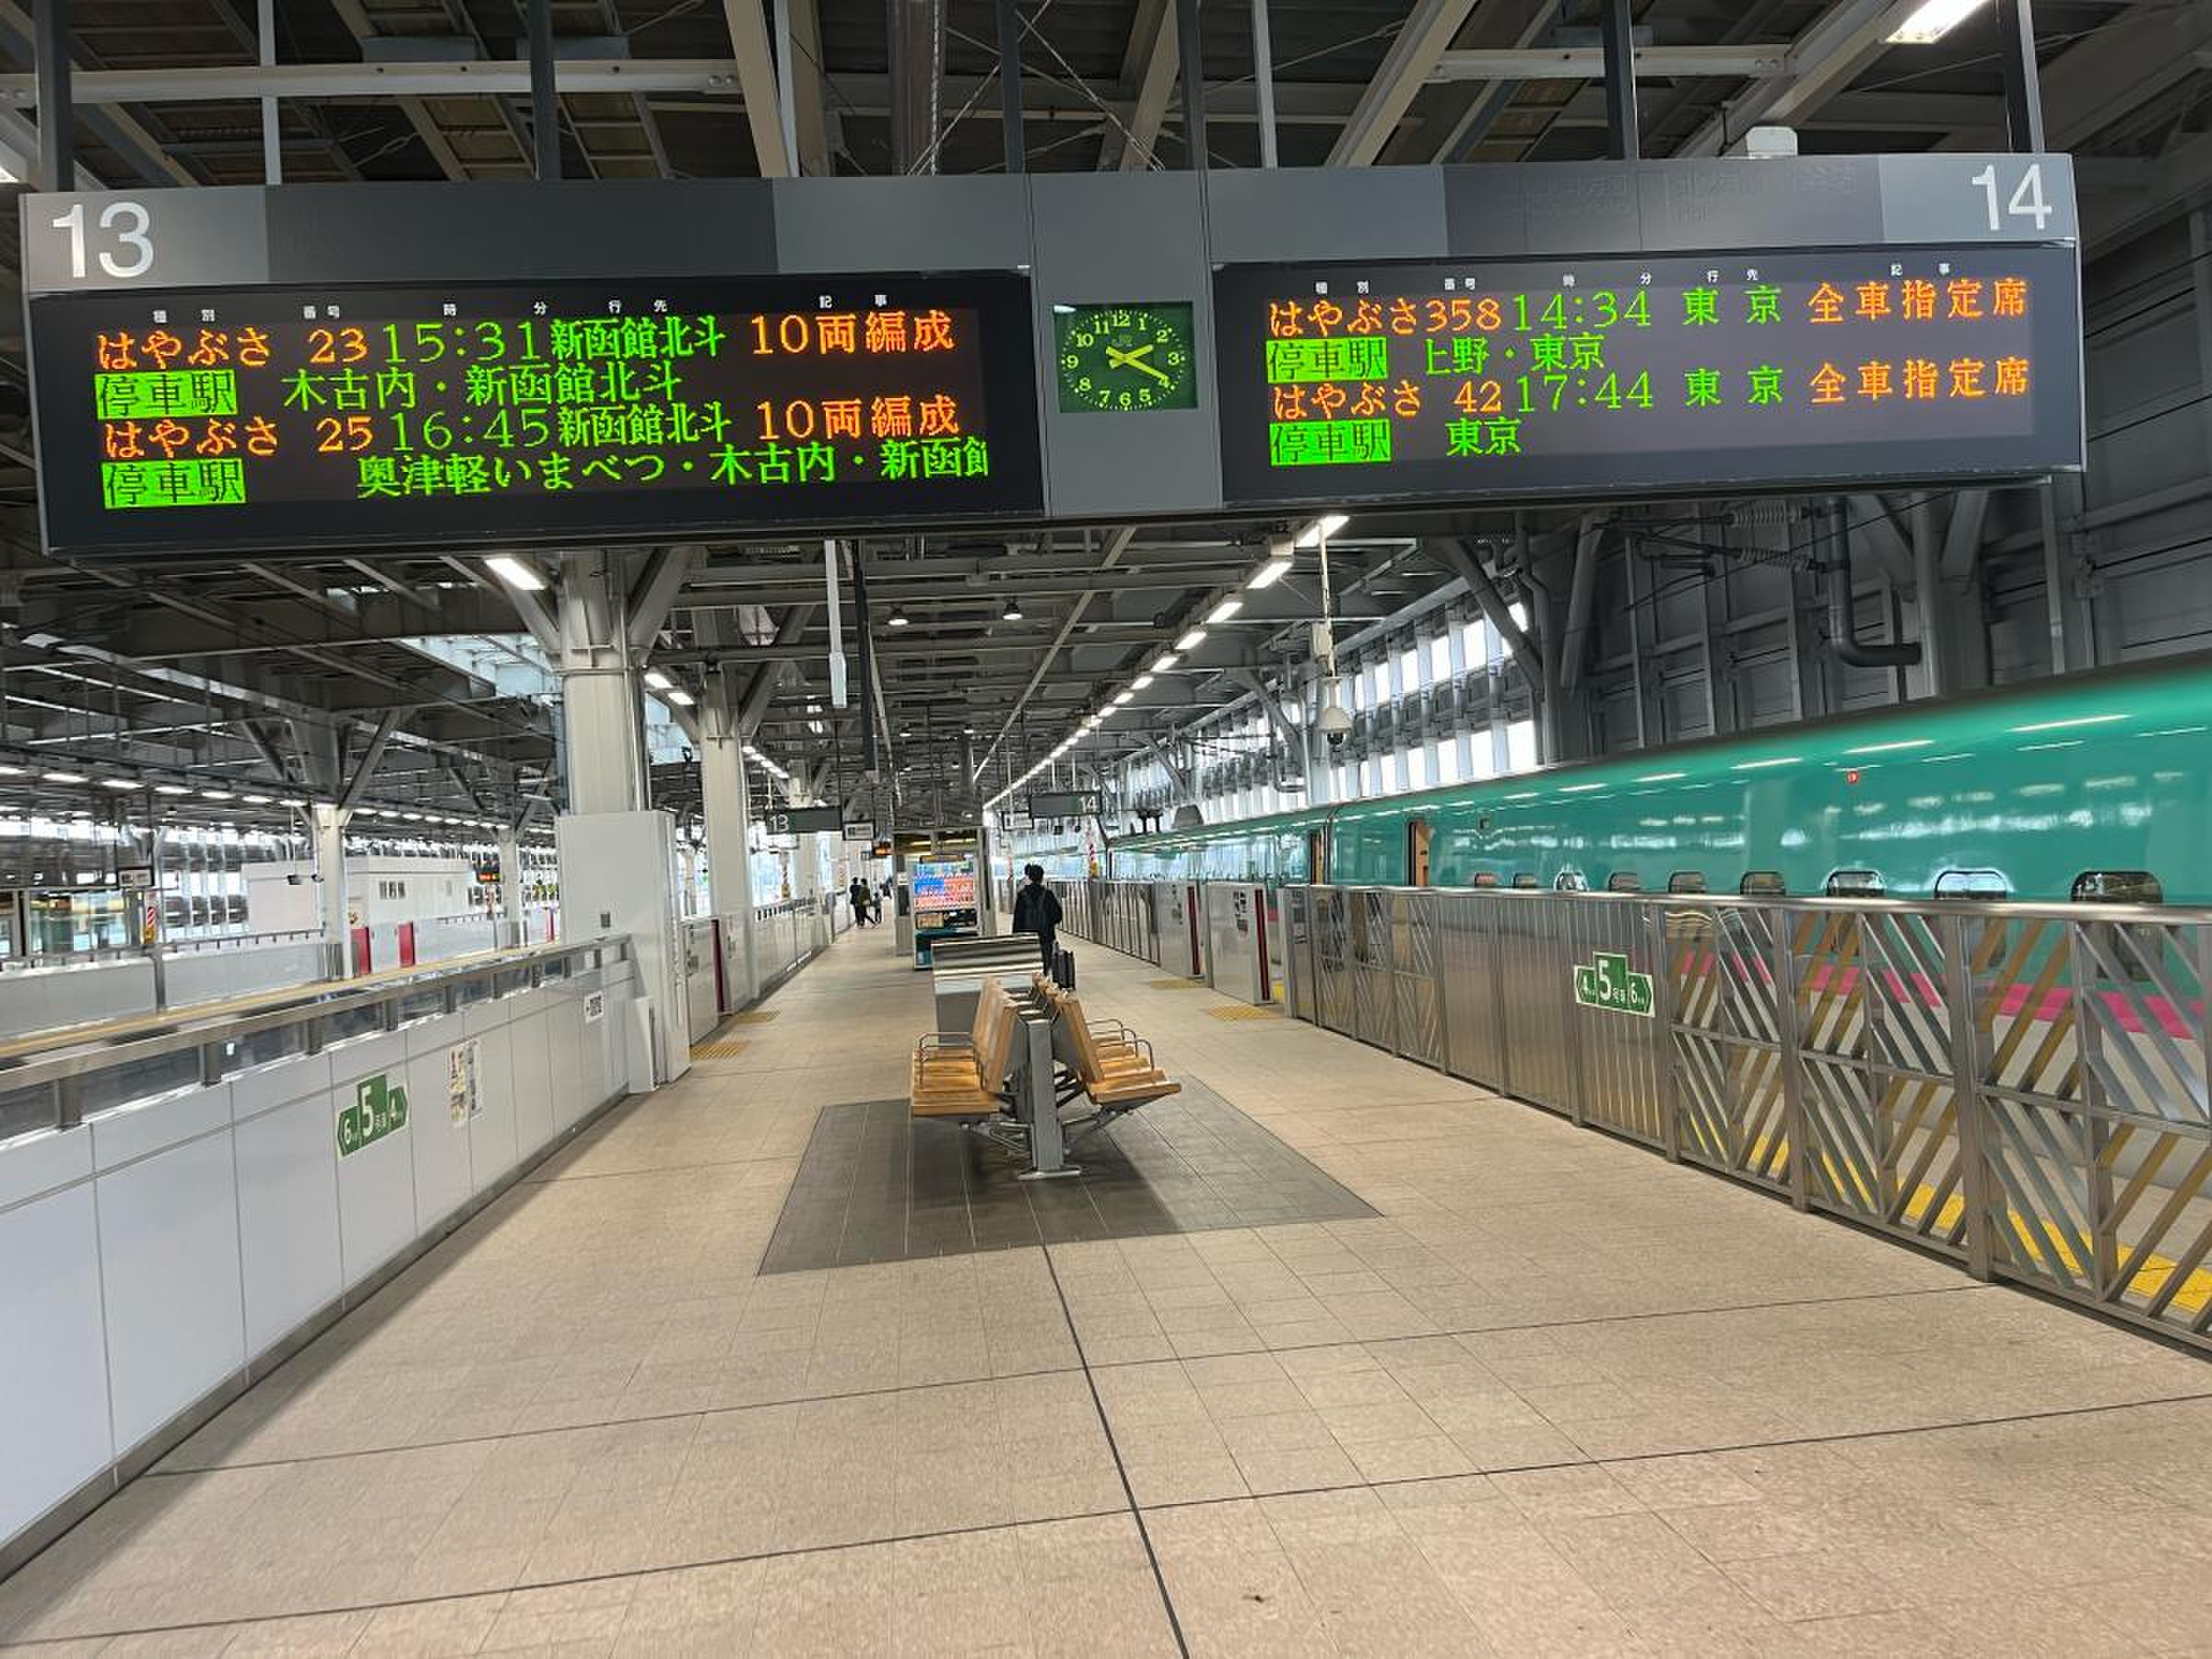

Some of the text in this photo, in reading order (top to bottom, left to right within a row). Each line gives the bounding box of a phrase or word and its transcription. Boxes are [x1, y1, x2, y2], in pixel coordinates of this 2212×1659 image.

[1971, 163, 2052, 230] 14
[52, 201, 154, 278] 13
[1269, 276, 2028, 337] はやぶさ 358 14:34 東京 全車指定席
[98, 309, 955, 370] はやぶさ 23 15:31 新函館北斗 10両編成
[1268, 332, 1604, 380] 停車駅 上野・東京
[98, 372, 236, 417] 停車駅
[1273, 356, 2030, 419] はやぶさ 42 17:44 東京 全車指定席
[104, 394, 960, 459] はやぶさ 25 16:45 新函館北斗 10両編成
[1271, 415, 1523, 463] 停車駅 東京
[104, 461, 243, 507] 停車駅
[770, 814, 789, 832] 13
